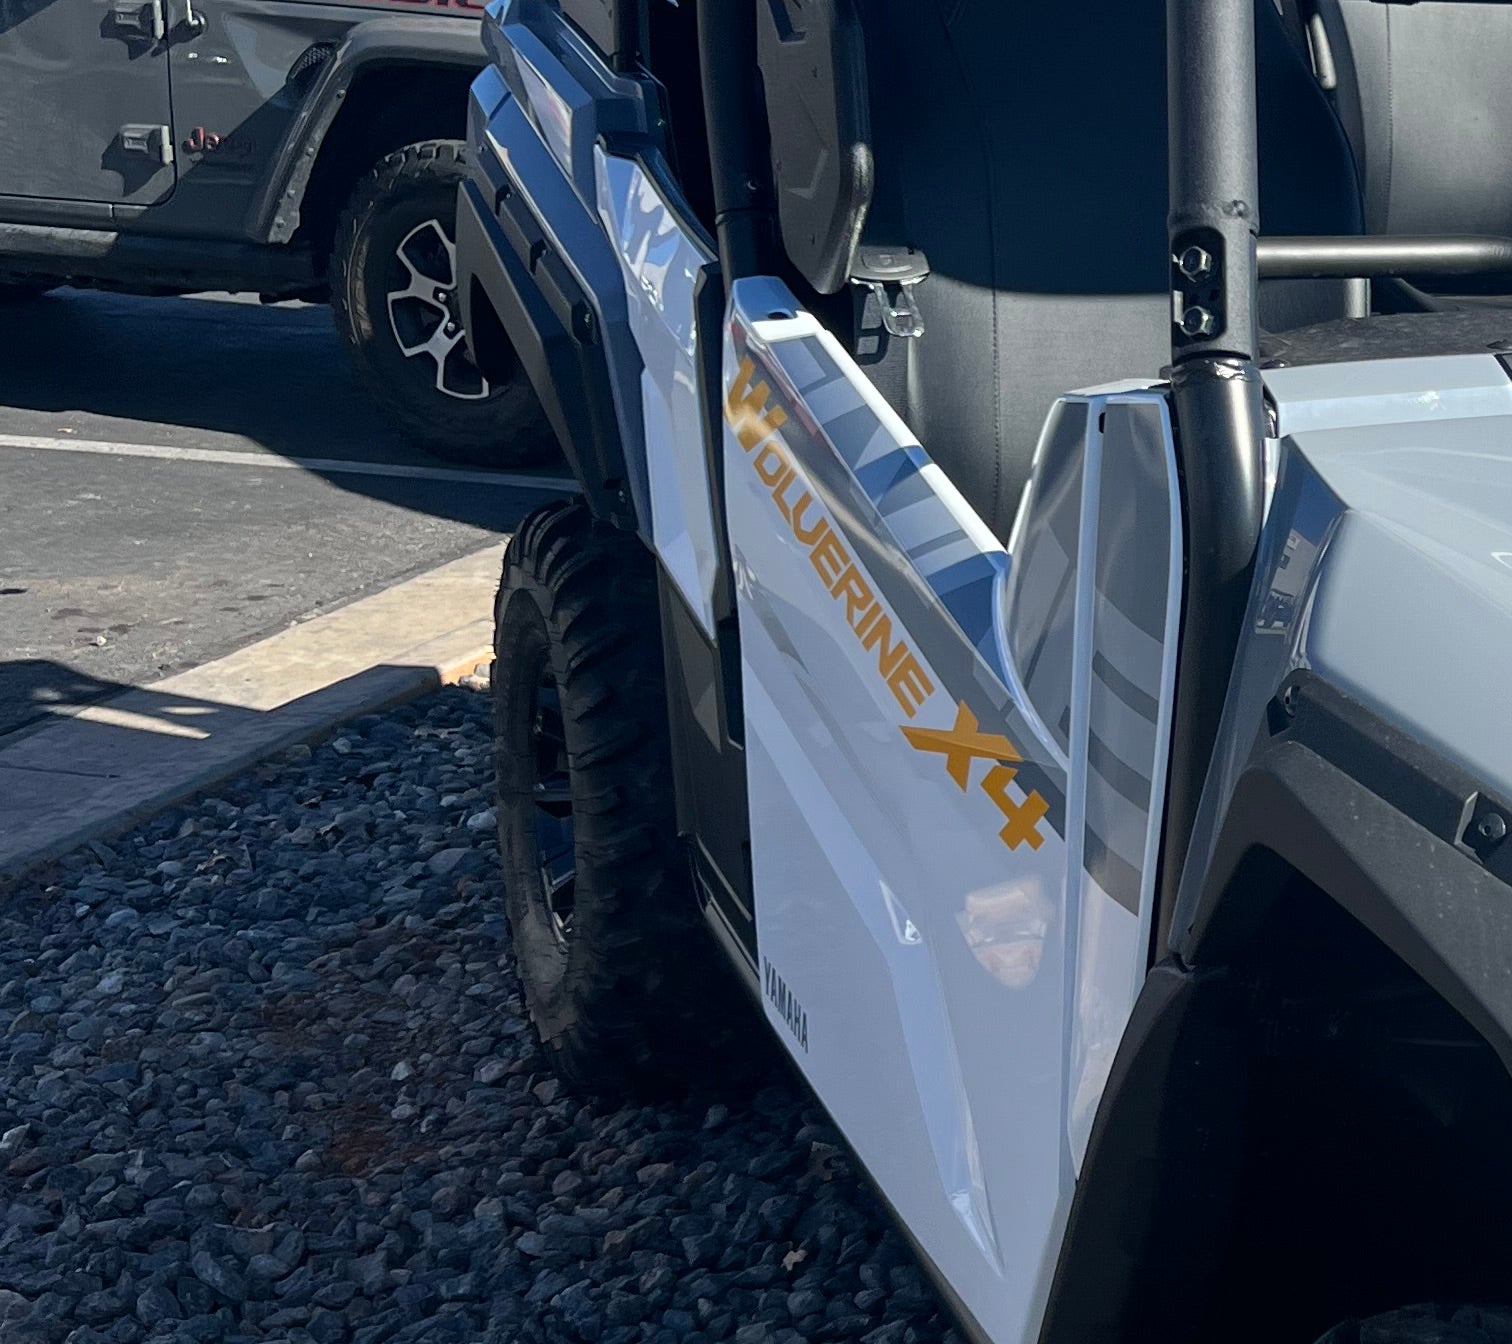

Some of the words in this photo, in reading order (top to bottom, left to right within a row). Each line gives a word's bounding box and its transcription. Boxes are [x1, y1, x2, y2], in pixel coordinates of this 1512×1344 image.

[724, 356, 935, 719] WOLVERINE
[901, 699, 1050, 852] X4
[764, 955, 810, 1055] YAMAHA
